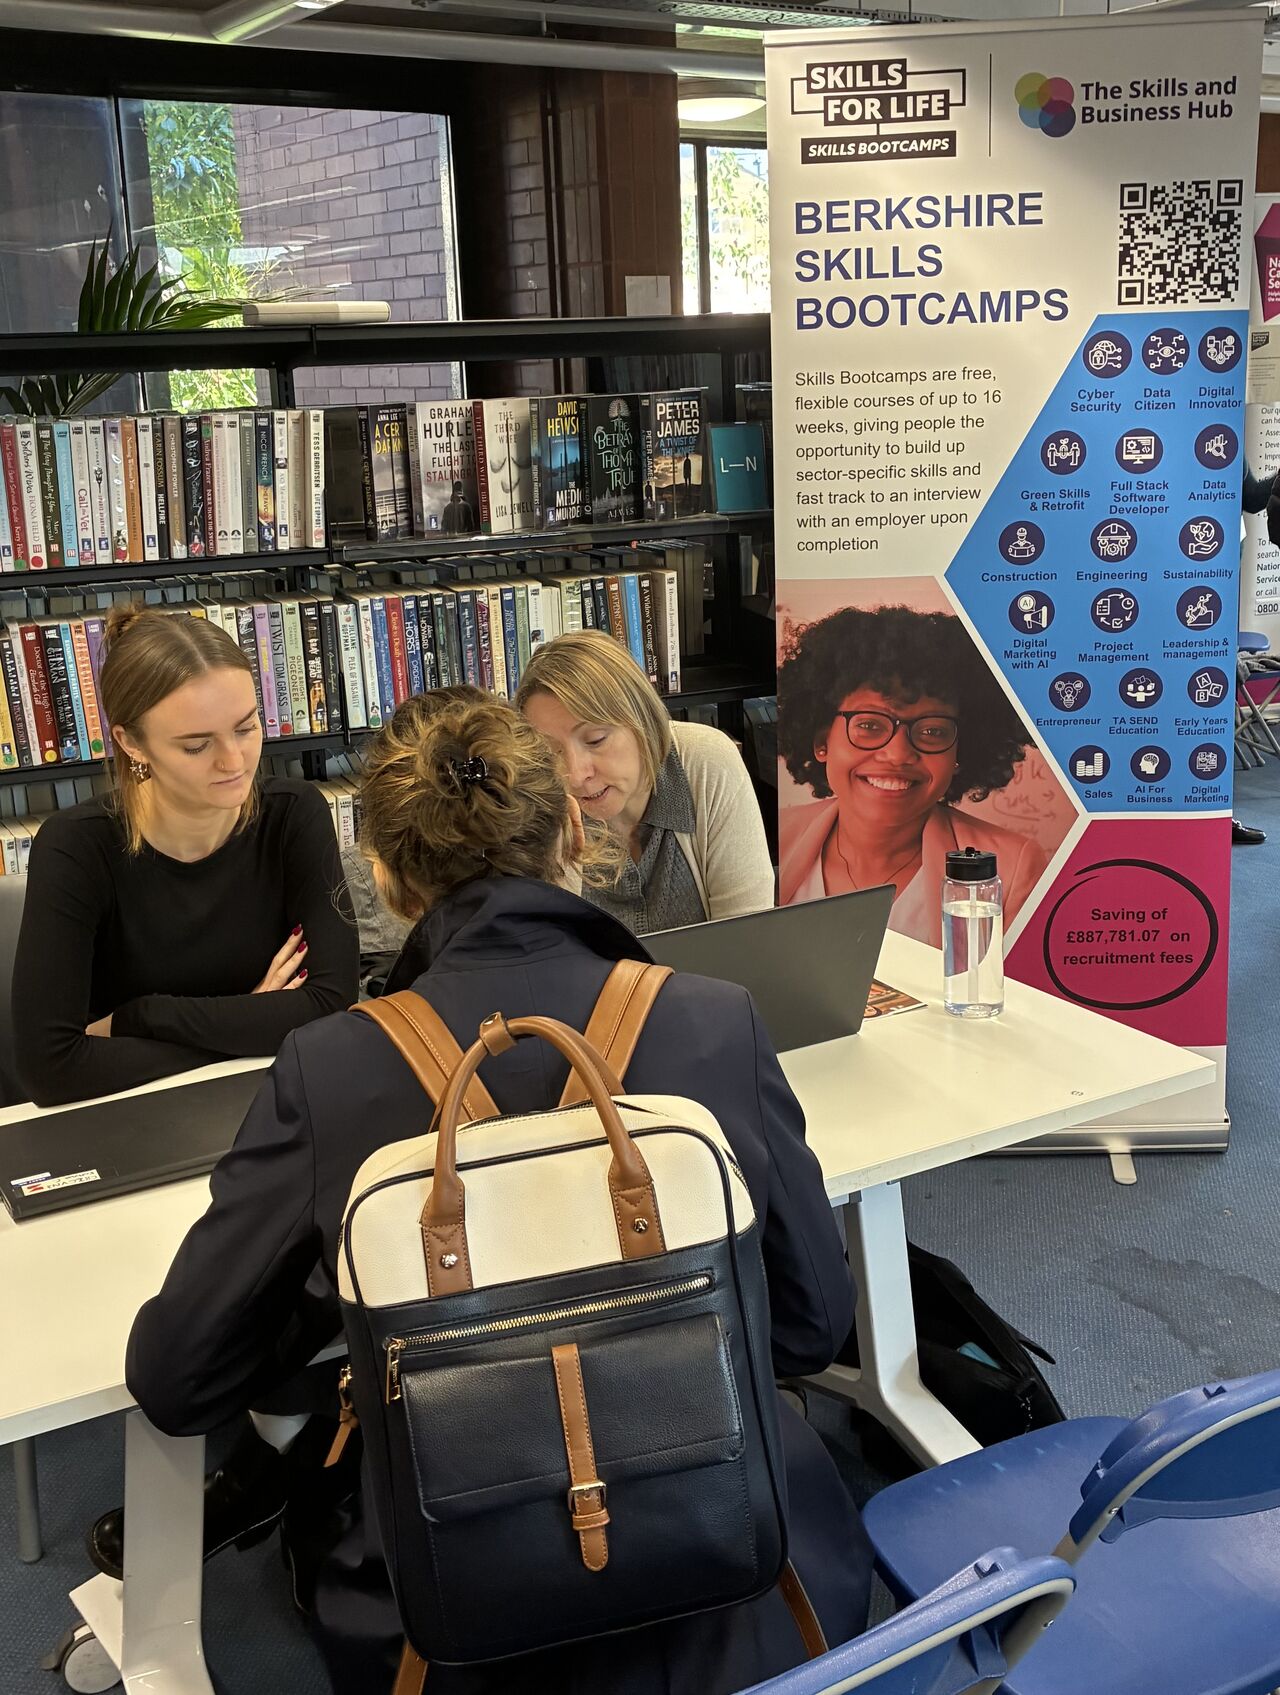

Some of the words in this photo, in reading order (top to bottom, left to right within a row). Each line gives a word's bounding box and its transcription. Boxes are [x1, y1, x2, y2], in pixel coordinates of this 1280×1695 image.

[810, 63, 903, 90] SKILLS
[1081, 82, 1121, 100] The
[1130, 79, 1188, 99] Skills
[1200, 76, 1236, 96] and
[827, 96, 882, 122] FOR
[889, 93, 945, 120] LIFE
[1082, 104, 1180, 125] Business
[1189, 100, 1233, 120] Hub
[808, 142, 856, 157] SKILLS
[857, 138, 950, 156] BOOTCAMPS
[795, 192, 1043, 234] BERKSHIRE
[795, 245, 943, 283] SKILLS
[796, 288, 1069, 330] BOOTCAMPS
[795, 372, 835, 386] Skills
[840, 370, 926, 385] Bootcamps
[932, 369, 956, 381] are
[962, 367, 996, 381] free,
[1078, 389, 1114, 400] Cyber
[1144, 388, 1171, 398] Data
[1199, 387, 1234, 398] Digital
[795, 396, 848, 410] flexible
[854, 394, 914, 408] courses
[920, 392, 934, 406] of
[939, 392, 957, 407] up
[963, 390, 977, 404] to
[983, 390, 1001, 403] 16
[1134, 400, 1176, 410] Citizen
[1189, 399, 1242, 410] Innovator
[430, 407, 472, 419] GRAHAM
[656, 401, 699, 420] PETER
[1070, 402, 1121, 413] Security
[498, 411, 513, 420] THE
[494, 423, 521, 434] THIRD
[611, 418, 629, 431] THE
[657, 419, 700, 438] JAMES
[796, 419, 848, 434] weeks,
[854, 419, 898, 435] giving
[904, 415, 955, 433] people
[961, 415, 984, 428] the
[498, 435, 517, 444] WIFE
[645, 430, 653, 454] PETER
[169, 433, 178, 472] CHRISTOPHER
[433, 442, 451, 453] THE
[796, 442, 880, 459] opportunity
[886, 442, 900, 455] to
[906, 440, 940, 454] build
[947, 441, 965, 455] up
[432, 455, 464, 468] FLIGHT
[313, 452, 321, 488] GERRITSEN
[796, 465, 906, 482] sector-specific
[910, 464, 947, 478] skills
[953, 463, 981, 476] and
[171, 473, 179, 498] FOWLER
[1111, 481, 1132, 490] Full
[1136, 480, 1169, 490] Stack
[1203, 480, 1226, 489] Data
[78, 488, 89, 508] Call
[797, 491, 823, 505] fast
[828, 490, 865, 504] track
[871, 490, 884, 502] to
[890, 490, 908, 502] an
[914, 487, 981, 501] interview
[1021, 490, 1056, 500] Green
[1059, 489, 1090, 498] Skills
[1113, 493, 1166, 502] Software
[1188, 490, 1236, 501] Analytics
[28, 495, 38, 520] FIONA
[157, 493, 166, 525] HELLFIRE
[495, 505, 507, 518] LISA
[1030, 502, 1038, 511] &
[1042, 500, 1084, 510] Retrofit
[1109, 504, 1169, 516] Developer
[64, 504, 74, 521] Katie
[79, 515, 90, 532] Vet
[797, 515, 826, 528] with
[831, 516, 849, 527] an
[855, 513, 925, 529] employer
[931, 512, 968, 527] upon
[31, 521, 39, 542] FIELD
[797, 538, 878, 553] completion
[1257, 550, 1279, 559] search
[981, 571, 1057, 582] Construction
[1076, 570, 1148, 582] Engineering
[1163, 569, 1233, 580] Sustainability
[1265, 587, 1277, 595] call
[643, 595, 652, 623] Widow's
[1258, 604, 1278, 613] 0800
[342, 624, 350, 652] HOFFMAN
[348, 624, 356, 650] JILLIANE
[405, 621, 416, 655] HORST
[420, 617, 429, 649] HOWARD
[644, 624, 654, 652] Courage
[271, 622, 285, 658] TWIST
[1013, 639, 1048, 650] Digital
[1162, 639, 1219, 649] Leadership
[1222, 638, 1229, 646] &
[1094, 642, 1133, 653] Project
[1163, 649, 1228, 659] management
[33, 646, 44, 670] Doctor
[1004, 650, 1056, 660] Marketing
[1078, 653, 1149, 663] Management
[296, 655, 304, 675] OLIVE
[348, 656, 356, 671] PLEA
[1012, 660, 1034, 669] with
[1038, 660, 1048, 668] AI
[275, 662, 286, 679] TOM
[349, 672, 356, 680] OF
[39, 679, 47, 691] the
[288, 656, 300, 703] PIGEONEER
[277, 681, 288, 707] GRASS
[350, 680, 359, 708] INSANITY
[40, 692, 51, 710] High
[44, 710, 53, 726] Fells
[1036, 718, 1101, 728] Entrepreneur
[1113, 717, 1126, 725] TA
[1130, 717, 1158, 725] SEND
[1175, 718, 1199, 727] Early
[1202, 717, 1228, 726] Years
[1109, 726, 1159, 735] Education
[1177, 726, 1224, 736] Education
[1085, 790, 1112, 798] Sales
[1135, 786, 1146, 794] AI
[1149, 785, 1165, 794] For
[1192, 786, 1220, 795] Digital
[1127, 794, 1172, 803] Business
[1184, 794, 1229, 804] Marketing
[1091, 908, 1146, 922] Saving
[1151, 908, 1168, 920] of
[1067, 930, 1160, 944] £887,781.07
[1170, 932, 1190, 942] on
[1063, 952, 1155, 965] recruitment
[1160, 952, 1193, 963] fees
